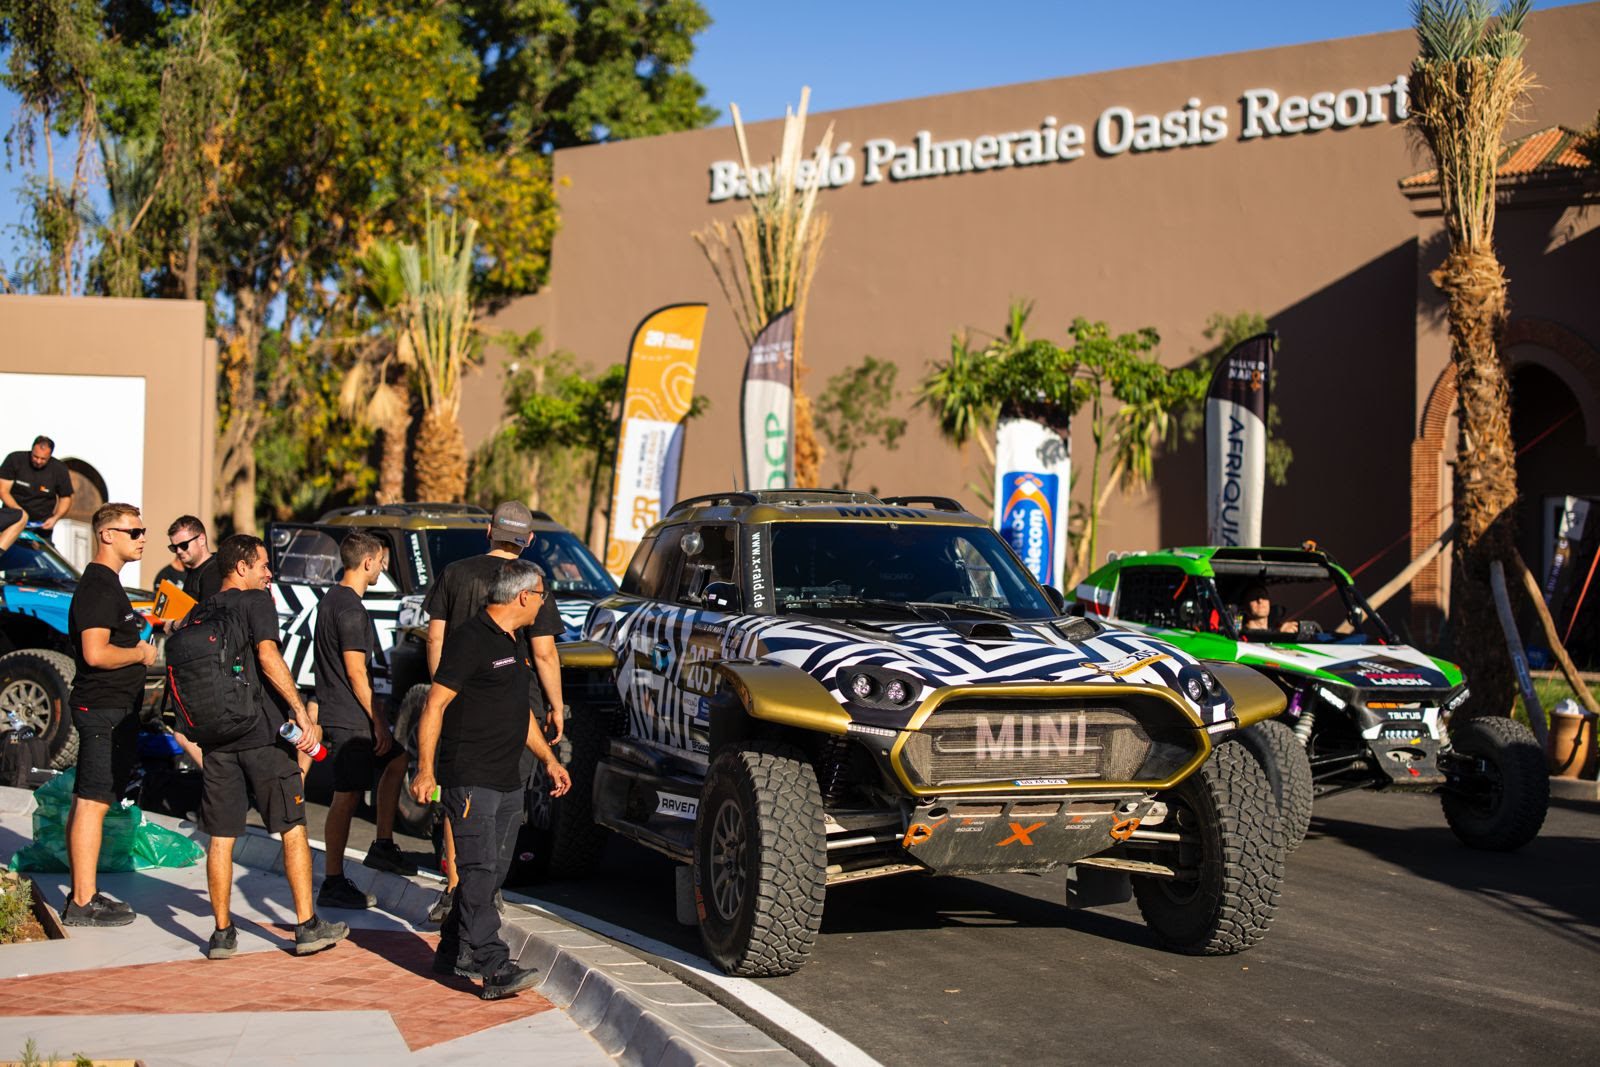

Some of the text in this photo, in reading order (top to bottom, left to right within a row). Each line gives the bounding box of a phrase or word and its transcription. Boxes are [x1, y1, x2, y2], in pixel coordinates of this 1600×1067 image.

[864, 115, 1086, 183] Palmeraie
[1097, 97, 1228, 155] Oasis
[1241, 74, 1408, 139] Resort
[834, 506, 928, 519] MINI
[1024, 509, 1044, 581] elecom
[751, 531, 766, 608] www.x-raid.de
[686, 644, 715, 694] 205
[1126, 650, 1160, 661] 205
[1369, 678, 1432, 686] LANDIA
[976, 714, 1087, 760] MINI
[995, 821, 1048, 847] X
